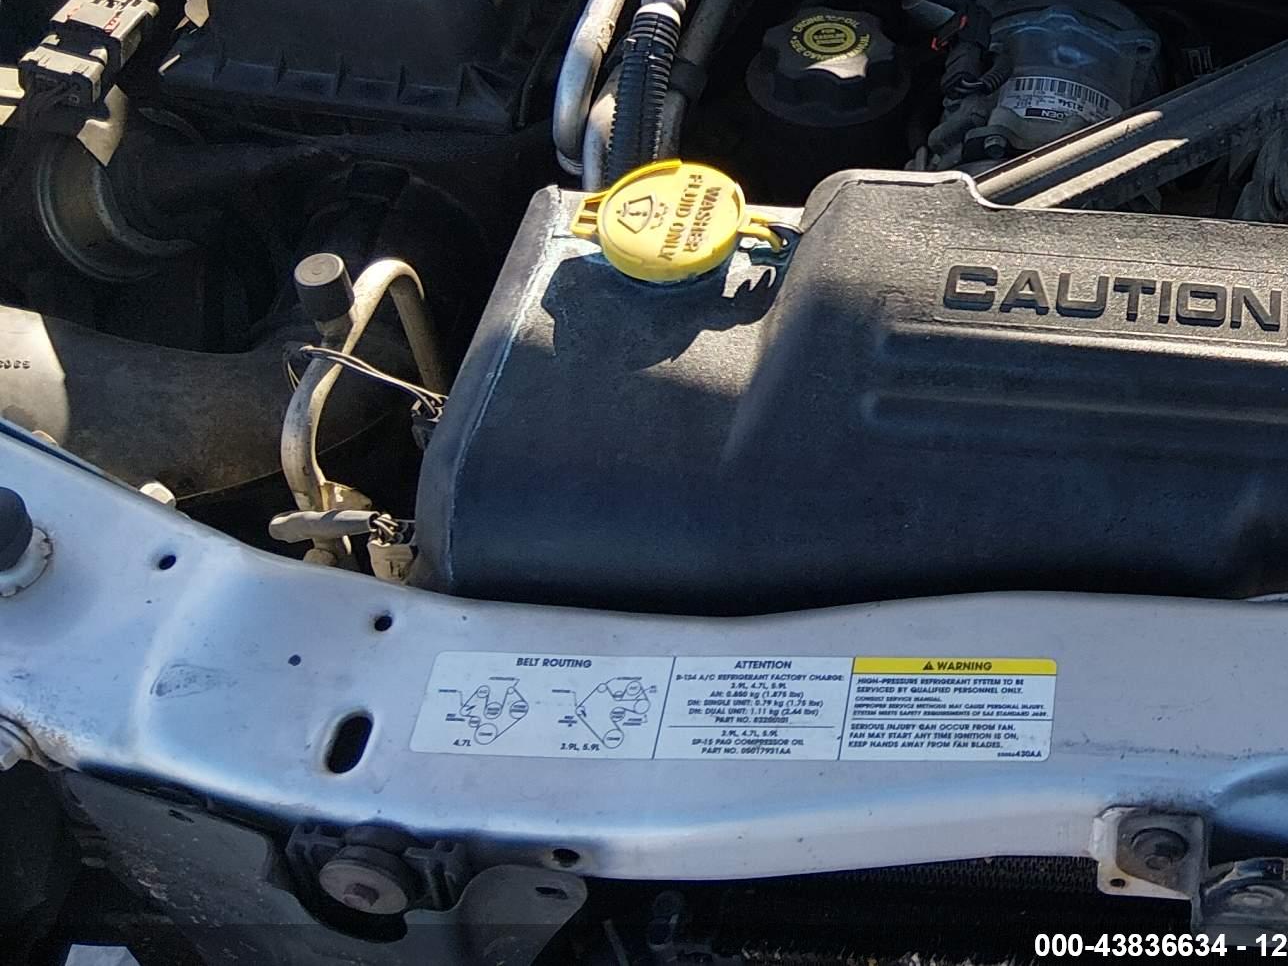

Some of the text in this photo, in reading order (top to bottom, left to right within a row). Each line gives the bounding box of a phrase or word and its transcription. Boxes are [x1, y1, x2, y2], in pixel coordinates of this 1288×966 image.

[657, 174, 703, 261] FLUID ONLY
[683, 186, 722, 252] WASHER
[943, 264, 1283, 331] CAUTION
[516, 658, 593, 669] BELT ROUTING
[734, 660, 793, 670] ATTENTION
[937, 661, 993, 671] WARNING
